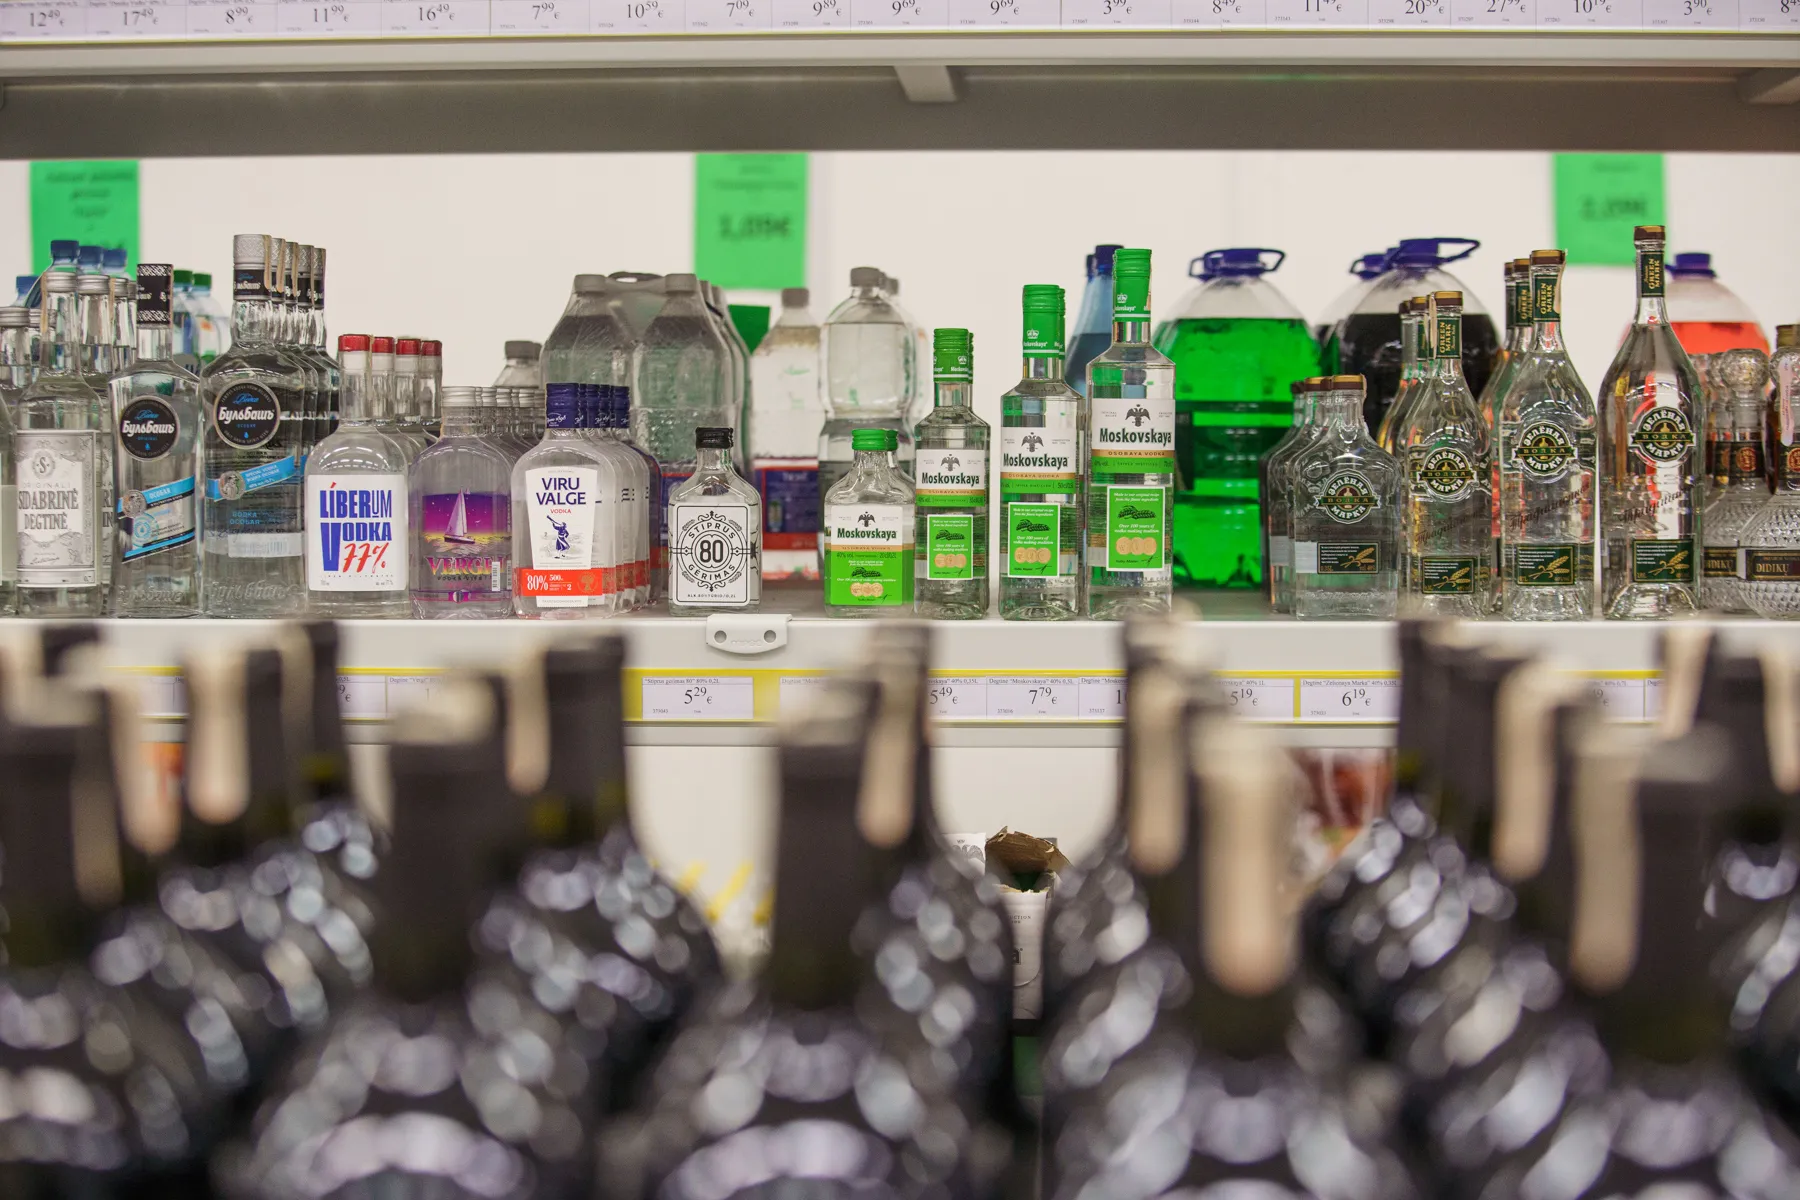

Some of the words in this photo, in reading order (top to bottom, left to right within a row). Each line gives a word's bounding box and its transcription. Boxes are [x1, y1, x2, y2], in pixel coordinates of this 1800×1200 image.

[1099, 428, 1172, 447] Moskovskaya
[1645, 443, 1684, 458] МАРКА
[1003, 453, 1068, 470] Moskovskaya
[1526, 456, 1563, 470] МАРКА
[541, 477, 580, 491] VIRU
[921, 472, 980, 487] Moskovskaya
[1430, 480, 1463, 493] МАРКА
[535, 491, 587, 505] VALGE
[1331, 505, 1366, 519] МАРКА
[688, 522, 736, 539] STIPRUS
[837, 528, 895, 541] Moskovskaya
[320, 522, 392, 571] VODKA
[700, 539, 724, 563] 80
[342, 542, 389, 574] 77%
[527, 574, 549, 590] 80%
